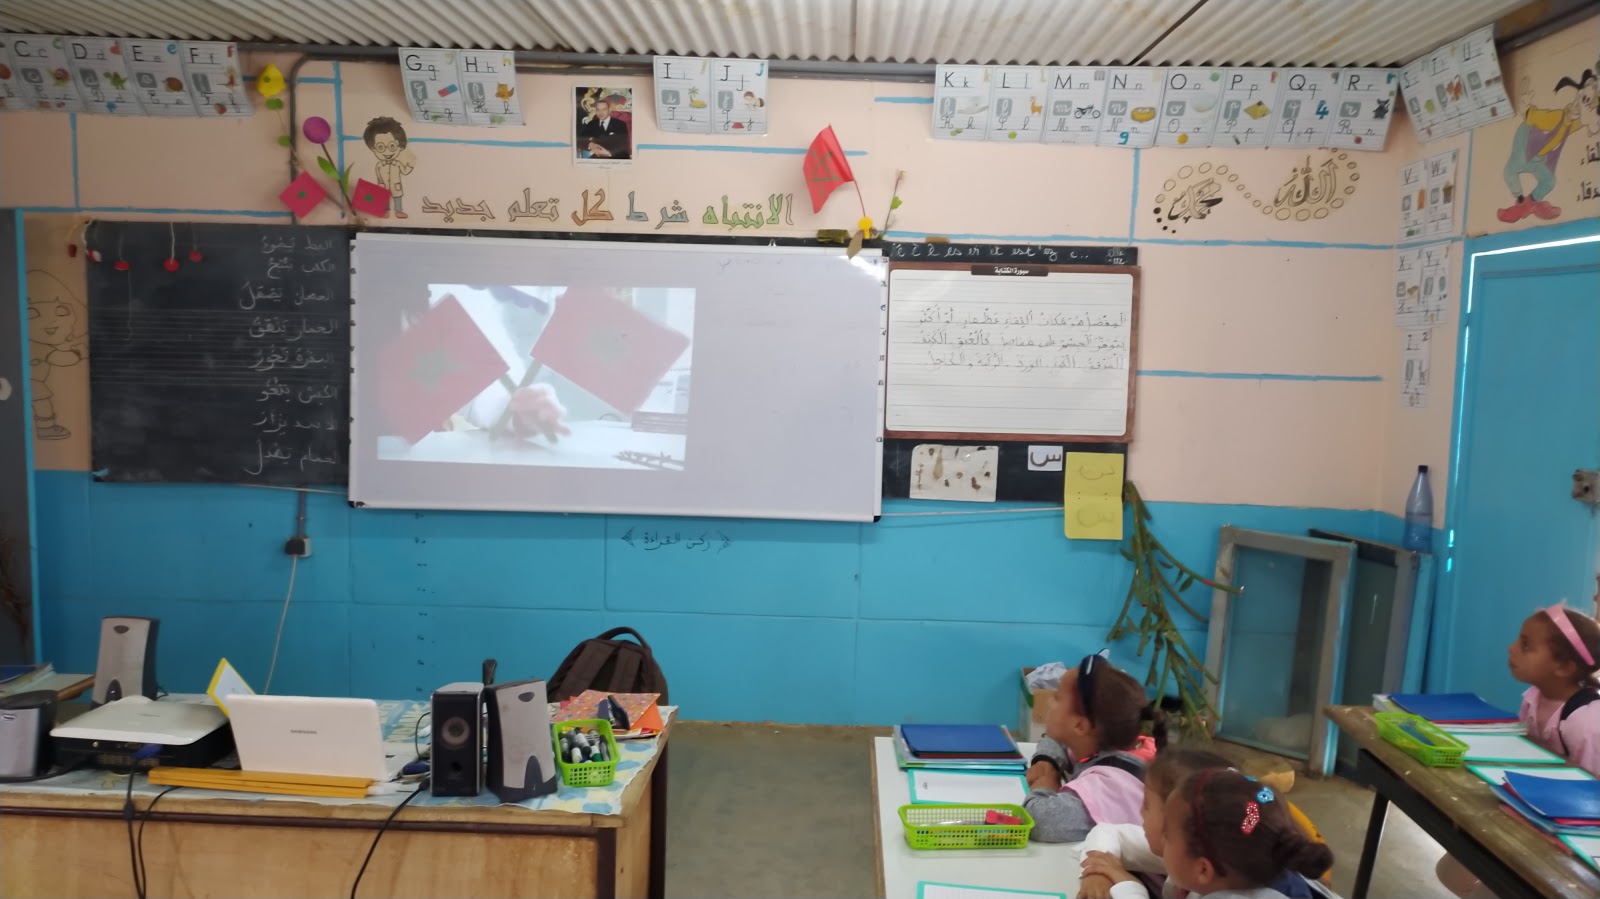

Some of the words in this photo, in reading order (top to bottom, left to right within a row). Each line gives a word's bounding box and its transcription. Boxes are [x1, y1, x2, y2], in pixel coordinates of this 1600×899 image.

[14, 40, 31, 57] C
[72, 43, 87, 59] D
[132, 45, 144, 62] E
[190, 48, 199, 63] F
[405, 54, 422, 71] G
[428, 64, 437, 81] g
[465, 56, 478, 72] H
[486, 61, 495, 73] h
[663, 62, 671, 79] I
[720, 65, 731, 81] J
[943, 71, 955, 87] K
[1002, 72, 1010, 88] L
[1054, 74, 1072, 89] M
[1112, 74, 1127, 89] N
[1170, 73, 1187, 90] O
[1231, 74, 1243, 90] P
[1289, 74, 1306, 91] Q
[1348, 74, 1361, 91] R
[1274, 156, 1339, 207] الله
[421, 195, 496, 223] جديد
[508, 187, 560, 223] تعلم
[571, 188, 614, 227] كل
[701, 193, 794, 231] الانتباه
[1014, 267, 1029, 275] سبورة
[1030, 451, 1062, 467] س
